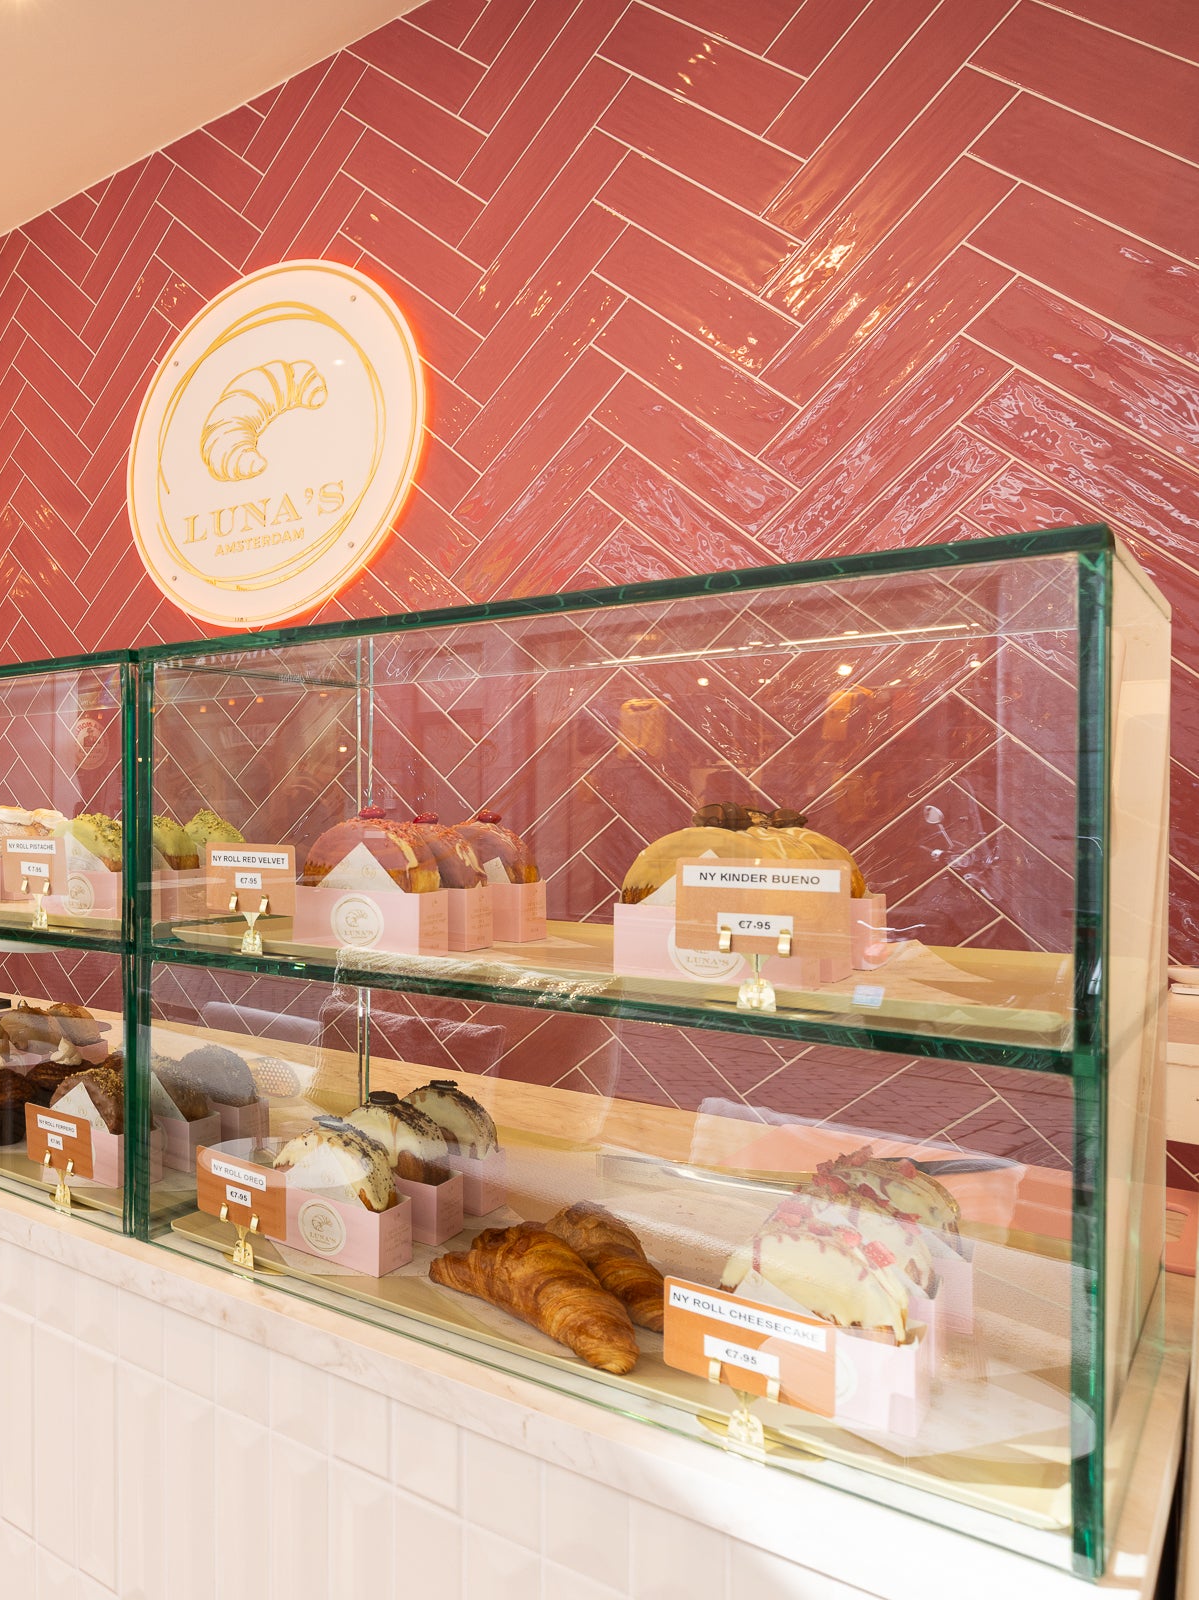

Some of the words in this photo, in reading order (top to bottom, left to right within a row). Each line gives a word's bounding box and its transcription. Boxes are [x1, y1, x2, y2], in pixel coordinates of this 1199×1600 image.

[182, 479, 345, 544] LUNA'S
[214, 527, 305, 557] AMSTERDAM
[258, 857, 285, 865] VELVET
[699, 872, 716, 881] NY
[720, 873, 768, 883] KINDER
[772, 874, 820, 885] BUENO
[686, 955, 730, 966] LUNA'S
[213, 1163, 223, 1172] NY
[224, 1167, 242, 1179] ROLL
[243, 1174, 264, 1186] OREO
[672, 1291, 690, 1304] NY
[693, 1298, 725, 1315] ROLL
[729, 1309, 820, 1343] CHEESECAKE
